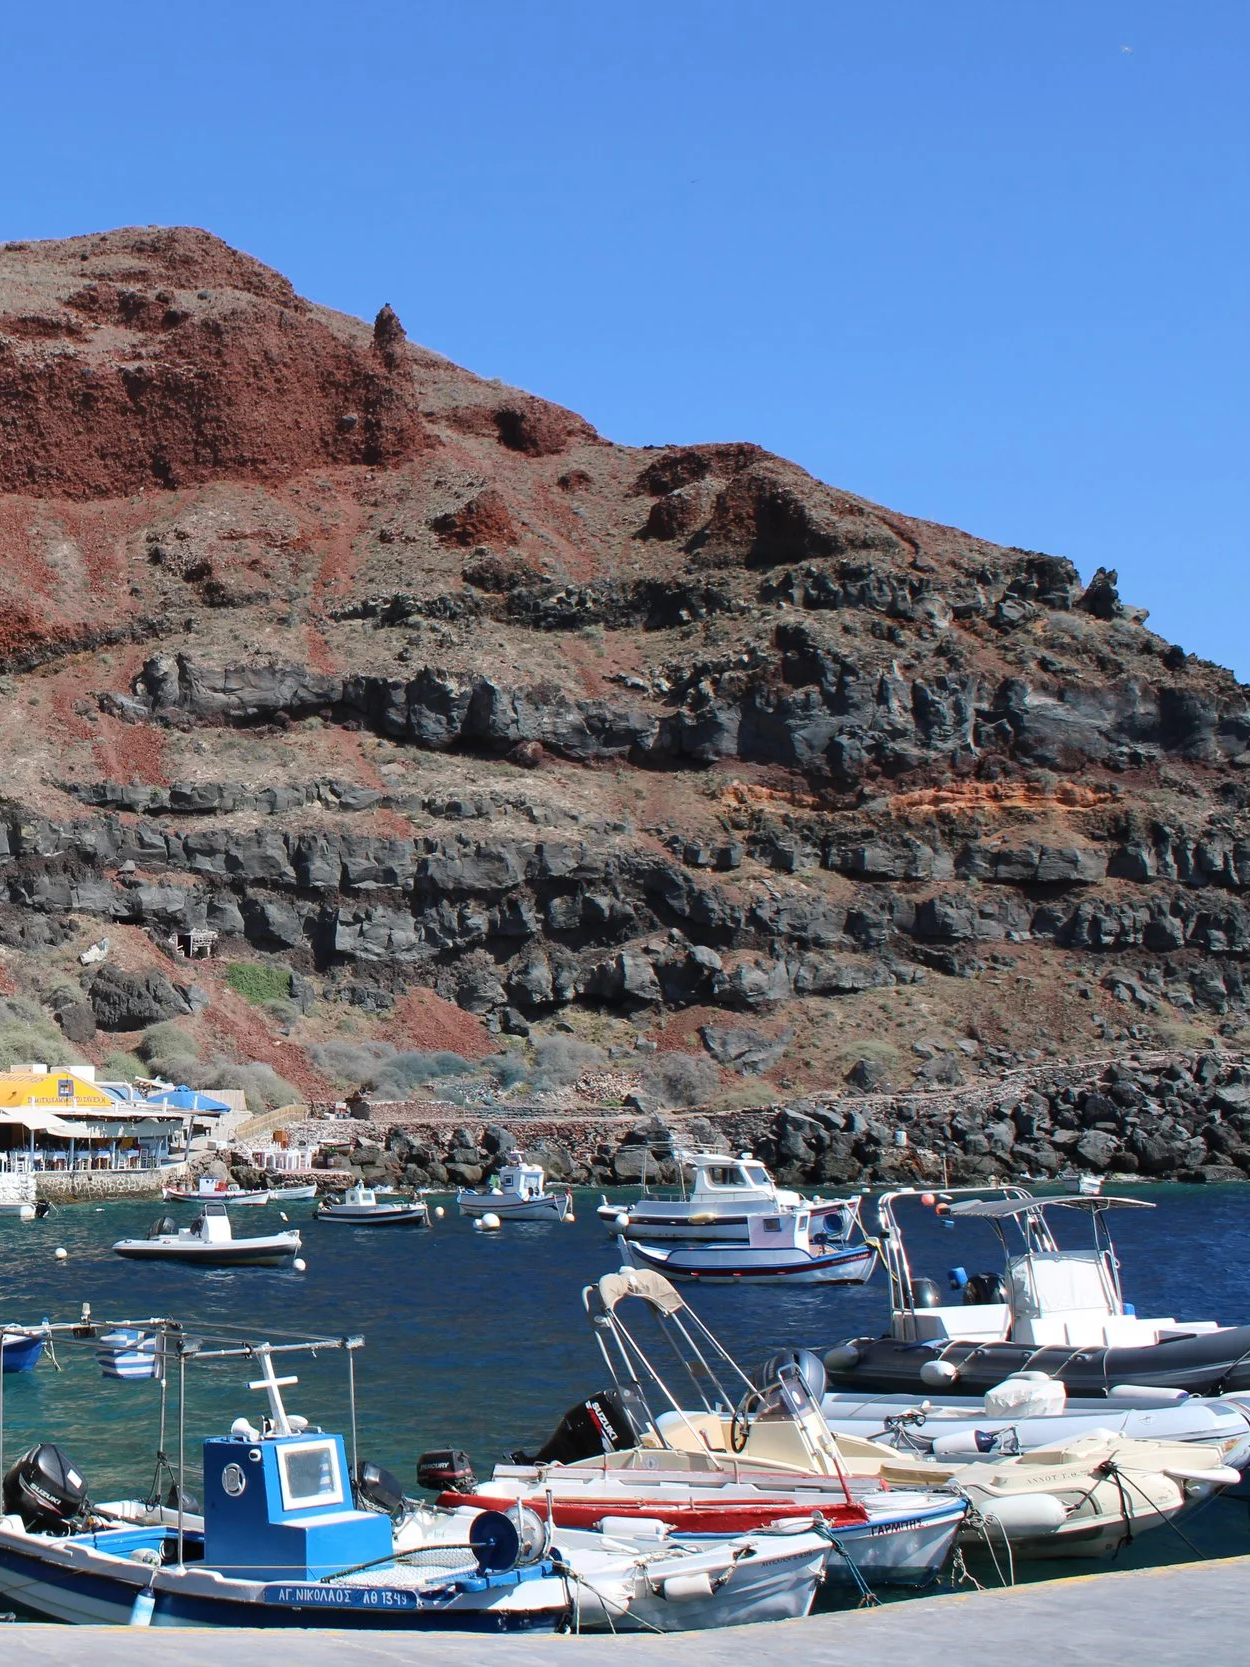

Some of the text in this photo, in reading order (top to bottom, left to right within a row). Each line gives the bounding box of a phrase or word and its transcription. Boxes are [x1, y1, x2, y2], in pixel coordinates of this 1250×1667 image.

[592, 1402, 619, 1441] SUZUKI
[421, 1462, 449, 1470] MERCURY
[30, 1483, 61, 1505] SUZUKI
